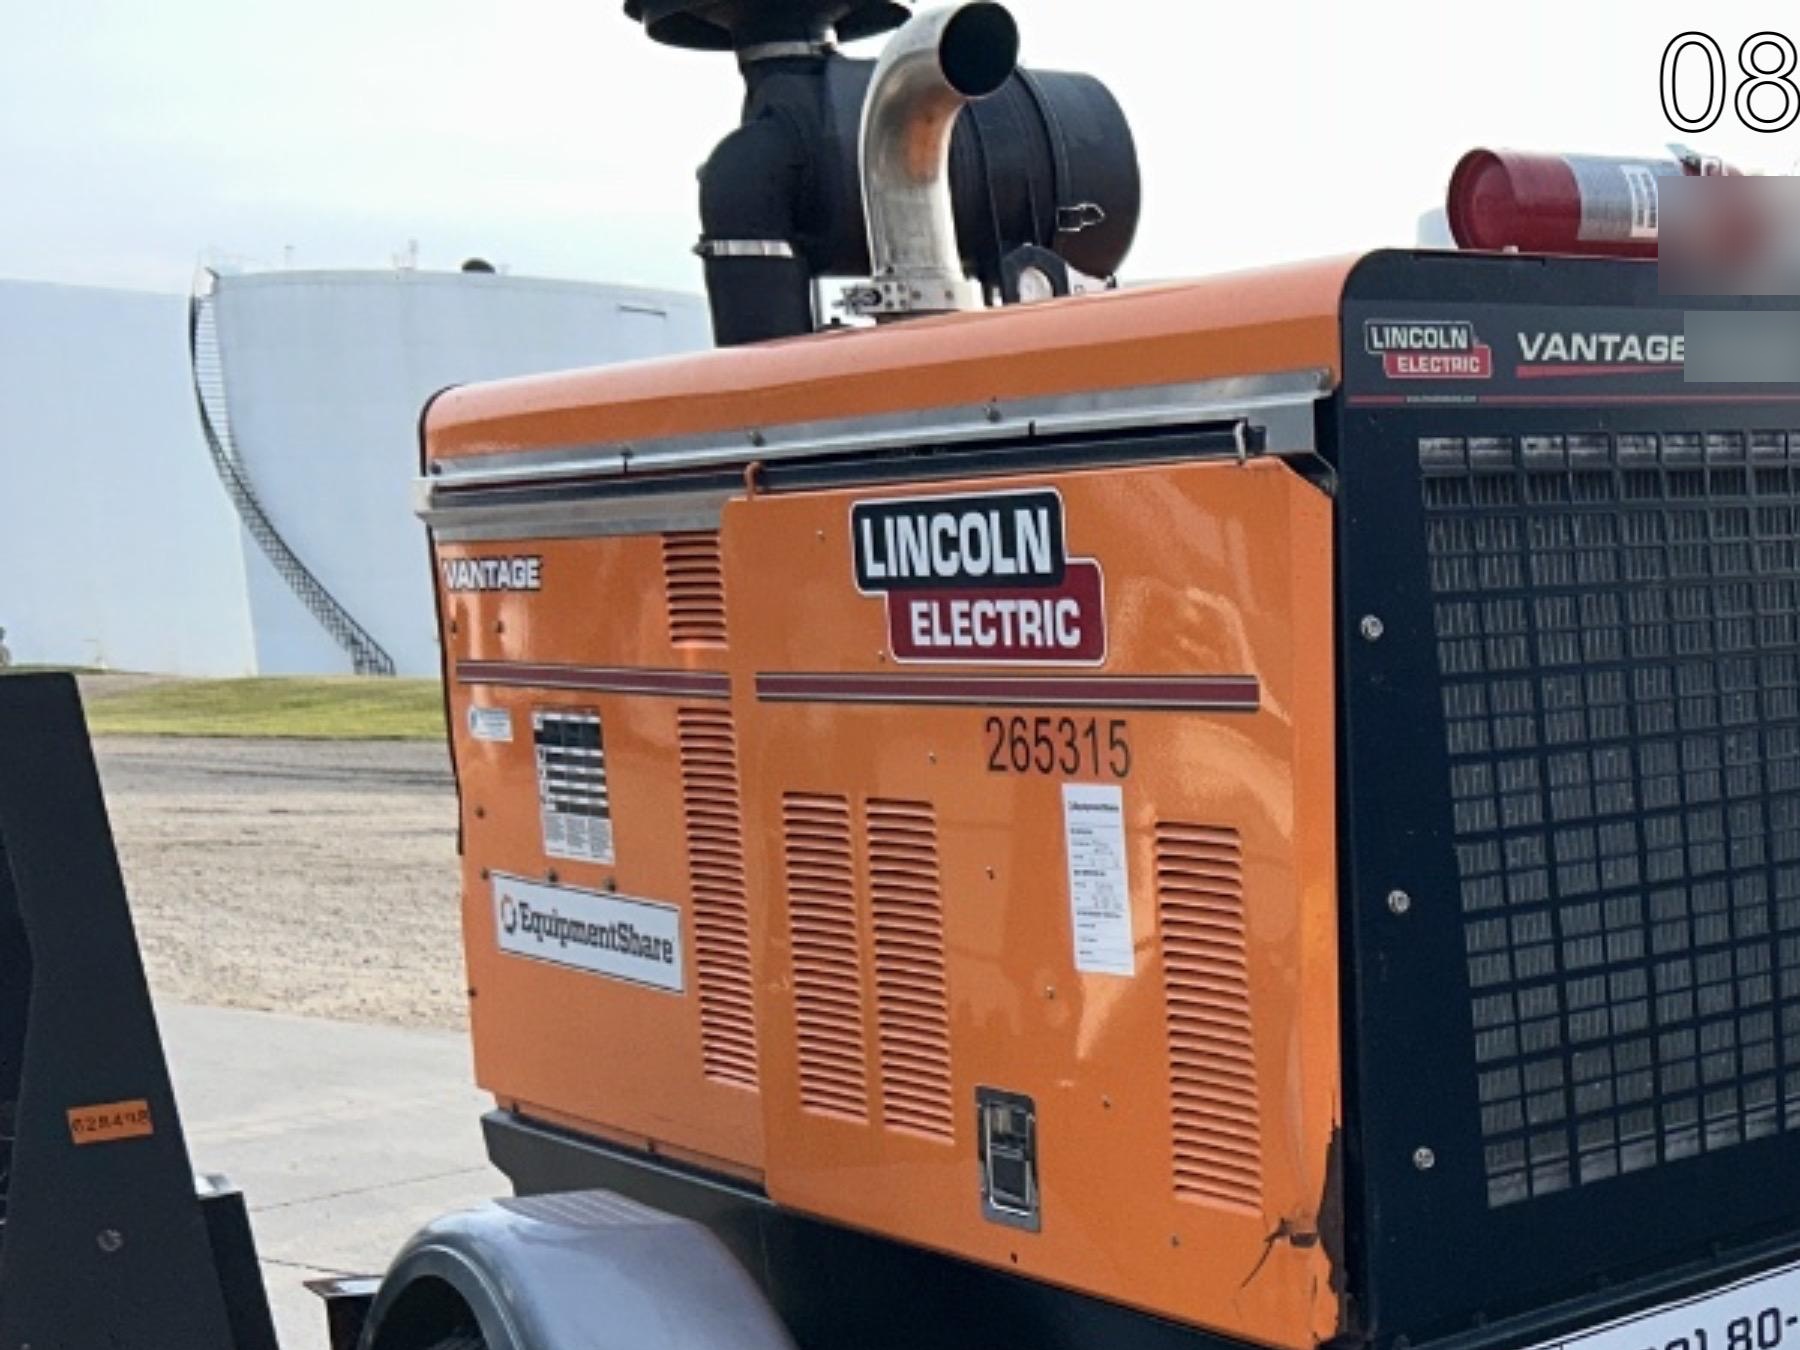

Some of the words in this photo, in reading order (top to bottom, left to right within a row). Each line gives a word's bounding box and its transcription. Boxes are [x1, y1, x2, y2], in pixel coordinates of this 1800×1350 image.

[1370, 325, 1468, 350] LINCOLN
[1516, 331, 1684, 362] VANTAGE
[1396, 355, 1480, 373] ELECTRIC
[861, 507, 1054, 579] LINCOLN
[443, 557, 543, 590] VANTAGE
[910, 598, 1082, 649] ELECTRIC
[985, 715, 1131, 779] 265315
[518, 901, 674, 965] EquipmentShare
